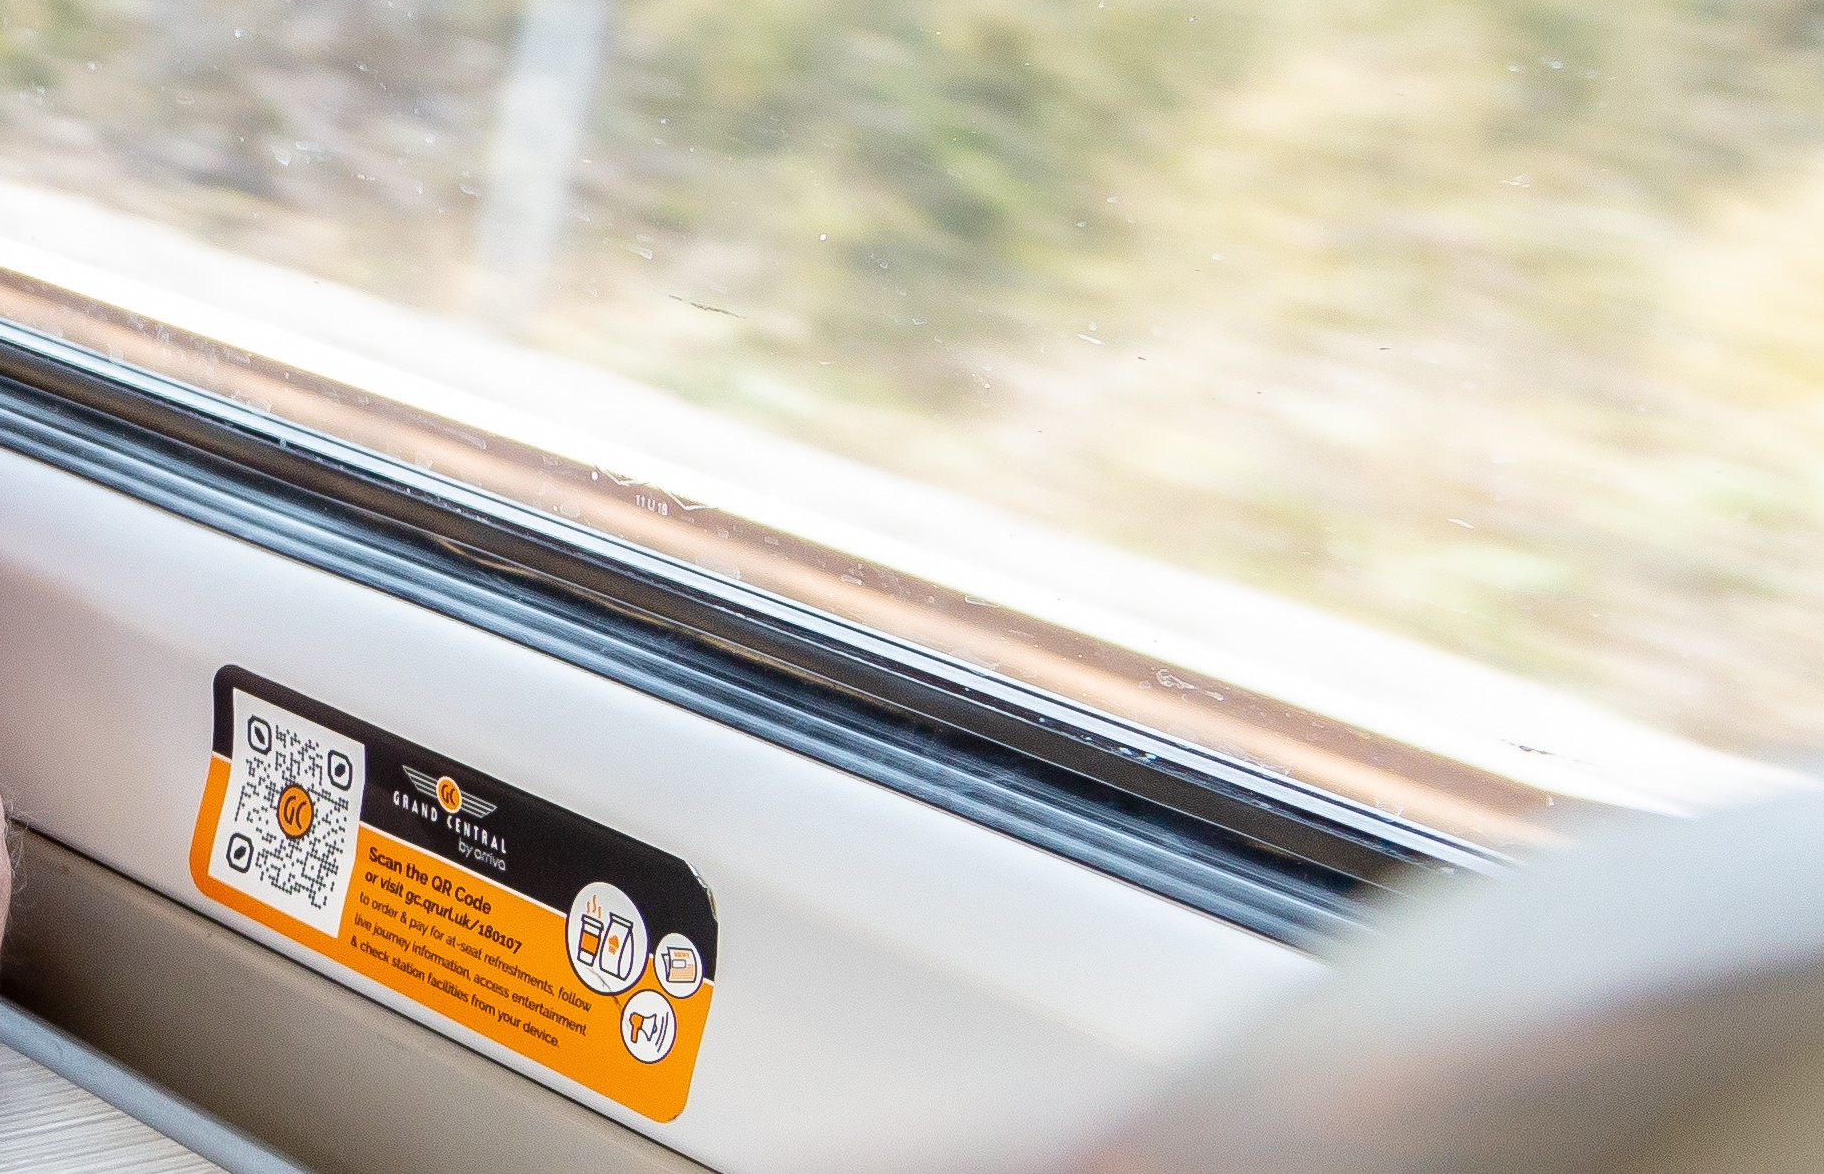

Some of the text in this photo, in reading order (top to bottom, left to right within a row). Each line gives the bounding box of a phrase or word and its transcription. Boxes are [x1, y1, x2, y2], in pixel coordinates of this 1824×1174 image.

[283, 795, 308, 830] GC
[393, 790, 507, 854] GRAND CENTRAL
[441, 783, 456, 806] GC
[368, 846, 492, 915] Scan the QR Code
[458, 837, 506, 871] by arriva
[364, 871, 523, 955] or visit gc.qrurl.uk/180107
[354, 912, 372, 932] live
[372, 922, 411, 952] journey
[473, 973, 510, 999] access
[511, 992, 587, 1037] entertainment
[359, 891, 370, 906] to
[371, 900, 398, 919] order
[399, 911, 407, 925] &
[408, 917, 428, 937] pay
[430, 925, 445, 941] for
[558, 986, 592, 1013] follow
[350, 935, 560, 1048] & check station facilities from your device.
